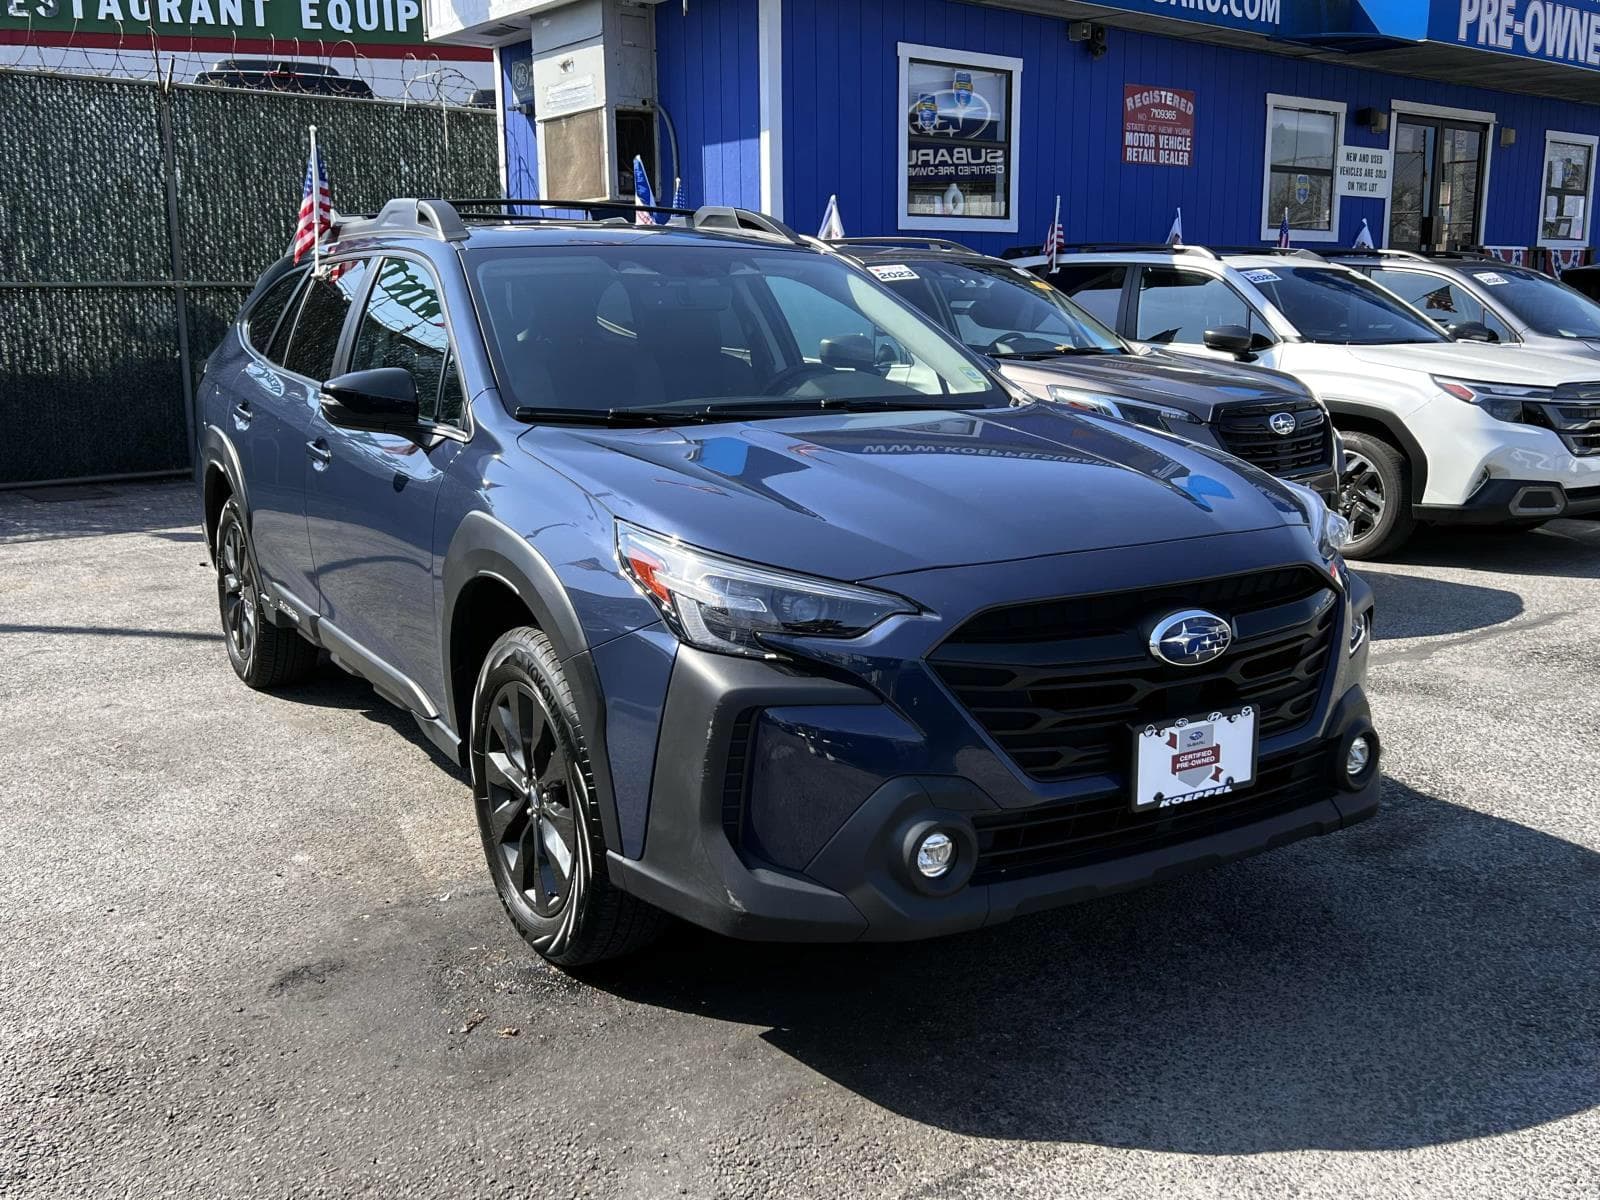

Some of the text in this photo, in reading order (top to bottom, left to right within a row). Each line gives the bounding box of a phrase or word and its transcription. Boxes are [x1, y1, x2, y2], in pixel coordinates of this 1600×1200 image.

[0, 0, 419, 33] ESTAURANT EQUIP
[1153, 0, 1280, 25] .COM
[1126, 90, 1194, 115] REGISTERED
[1126, 122, 1191, 136] STATE OF NEW YORK
[1125, 132, 1192, 151] MOTOR VEHICLE
[1126, 147, 1189, 166] RETAIL DEALER
[1346, 152, 1358, 162] NEW
[1359, 153, 1370, 163] AND
[1339, 166, 1363, 177] VEHICLES
[1364, 168, 1374, 178] ARE
[1347, 181, 1355, 191] ON
[1356, 181, 1368, 192] THIS
[878, 270, 915, 280] 2023
[1176, 755, 1216, 770] PRE-OWNED
[1179, 749, 1213, 762] CERTIFIED
[1159, 785, 1233, 808] KOEPPEL
